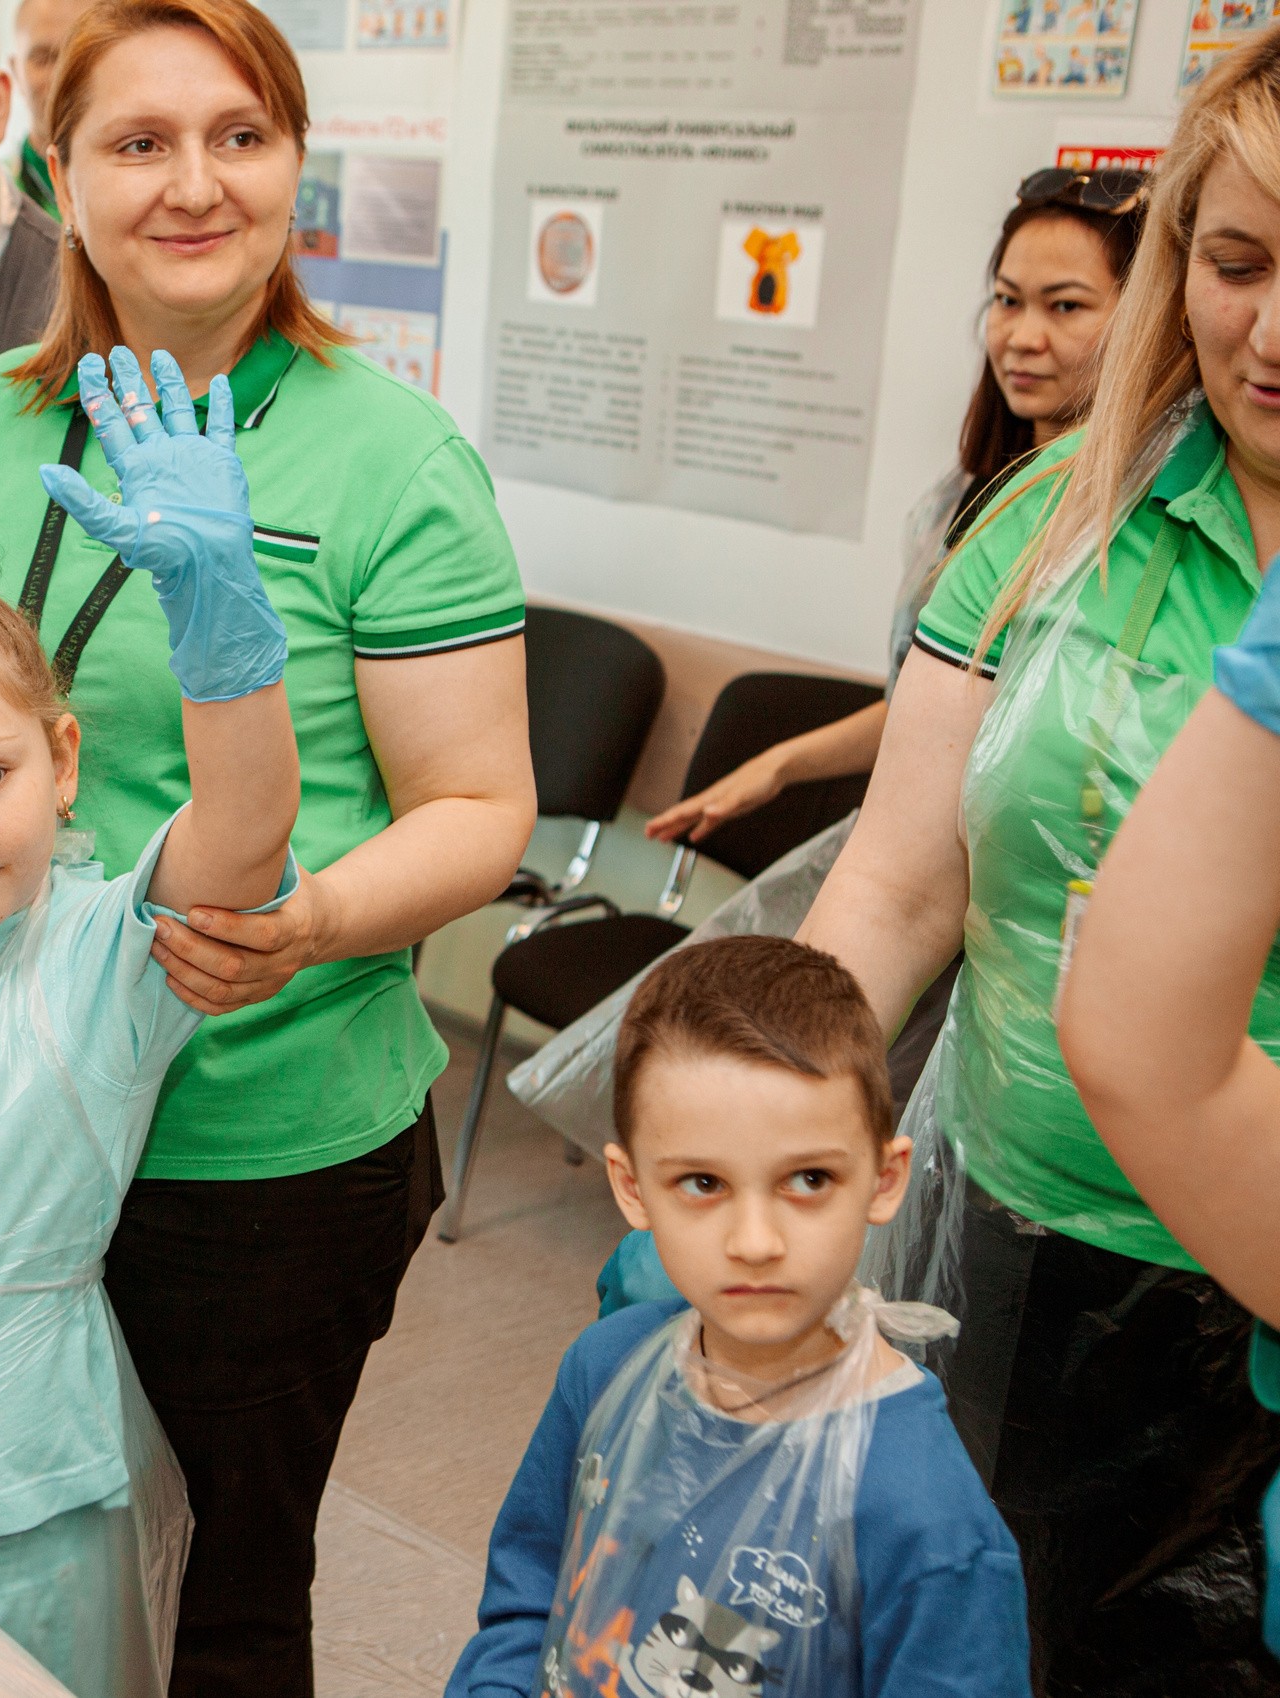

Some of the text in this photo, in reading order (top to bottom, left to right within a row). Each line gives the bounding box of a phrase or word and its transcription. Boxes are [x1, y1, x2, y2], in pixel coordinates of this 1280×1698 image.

[766, 1562, 808, 1598] WANT
[770, 1580, 781, 1597] A
[749, 1581, 804, 1623] TOY CAR
